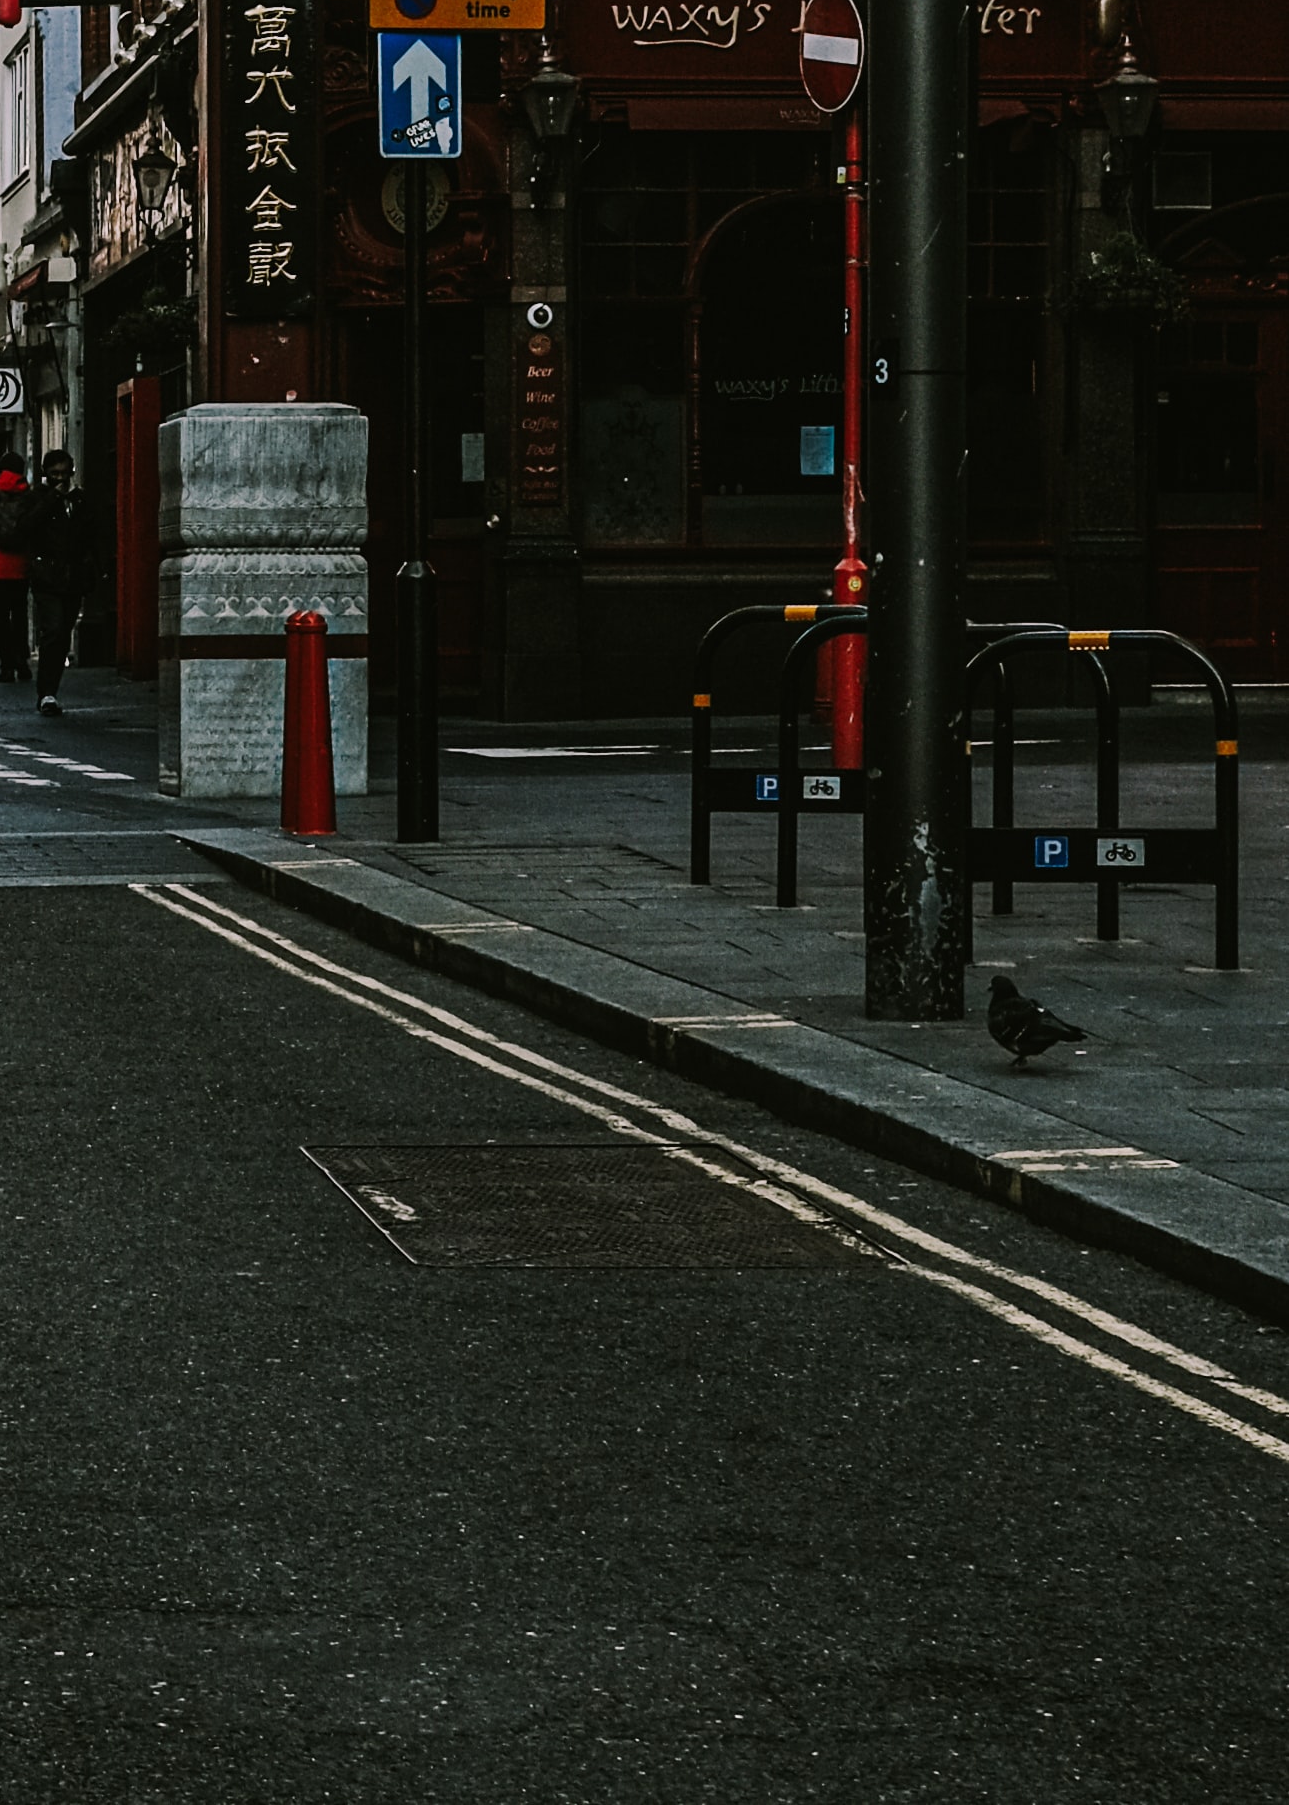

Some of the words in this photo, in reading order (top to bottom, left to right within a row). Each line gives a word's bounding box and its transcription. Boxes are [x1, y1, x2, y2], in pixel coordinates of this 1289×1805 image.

[466, 0, 511, 19] time
[527, 365, 554, 378] Beer
[875, 357, 889, 384] 3
[526, 391, 556, 404] Wine
[522, 416, 559, 432] Coffee
[526, 443, 557, 456] Food
[763, 777, 777, 797] P
[1044, 840, 1062, 863] P
